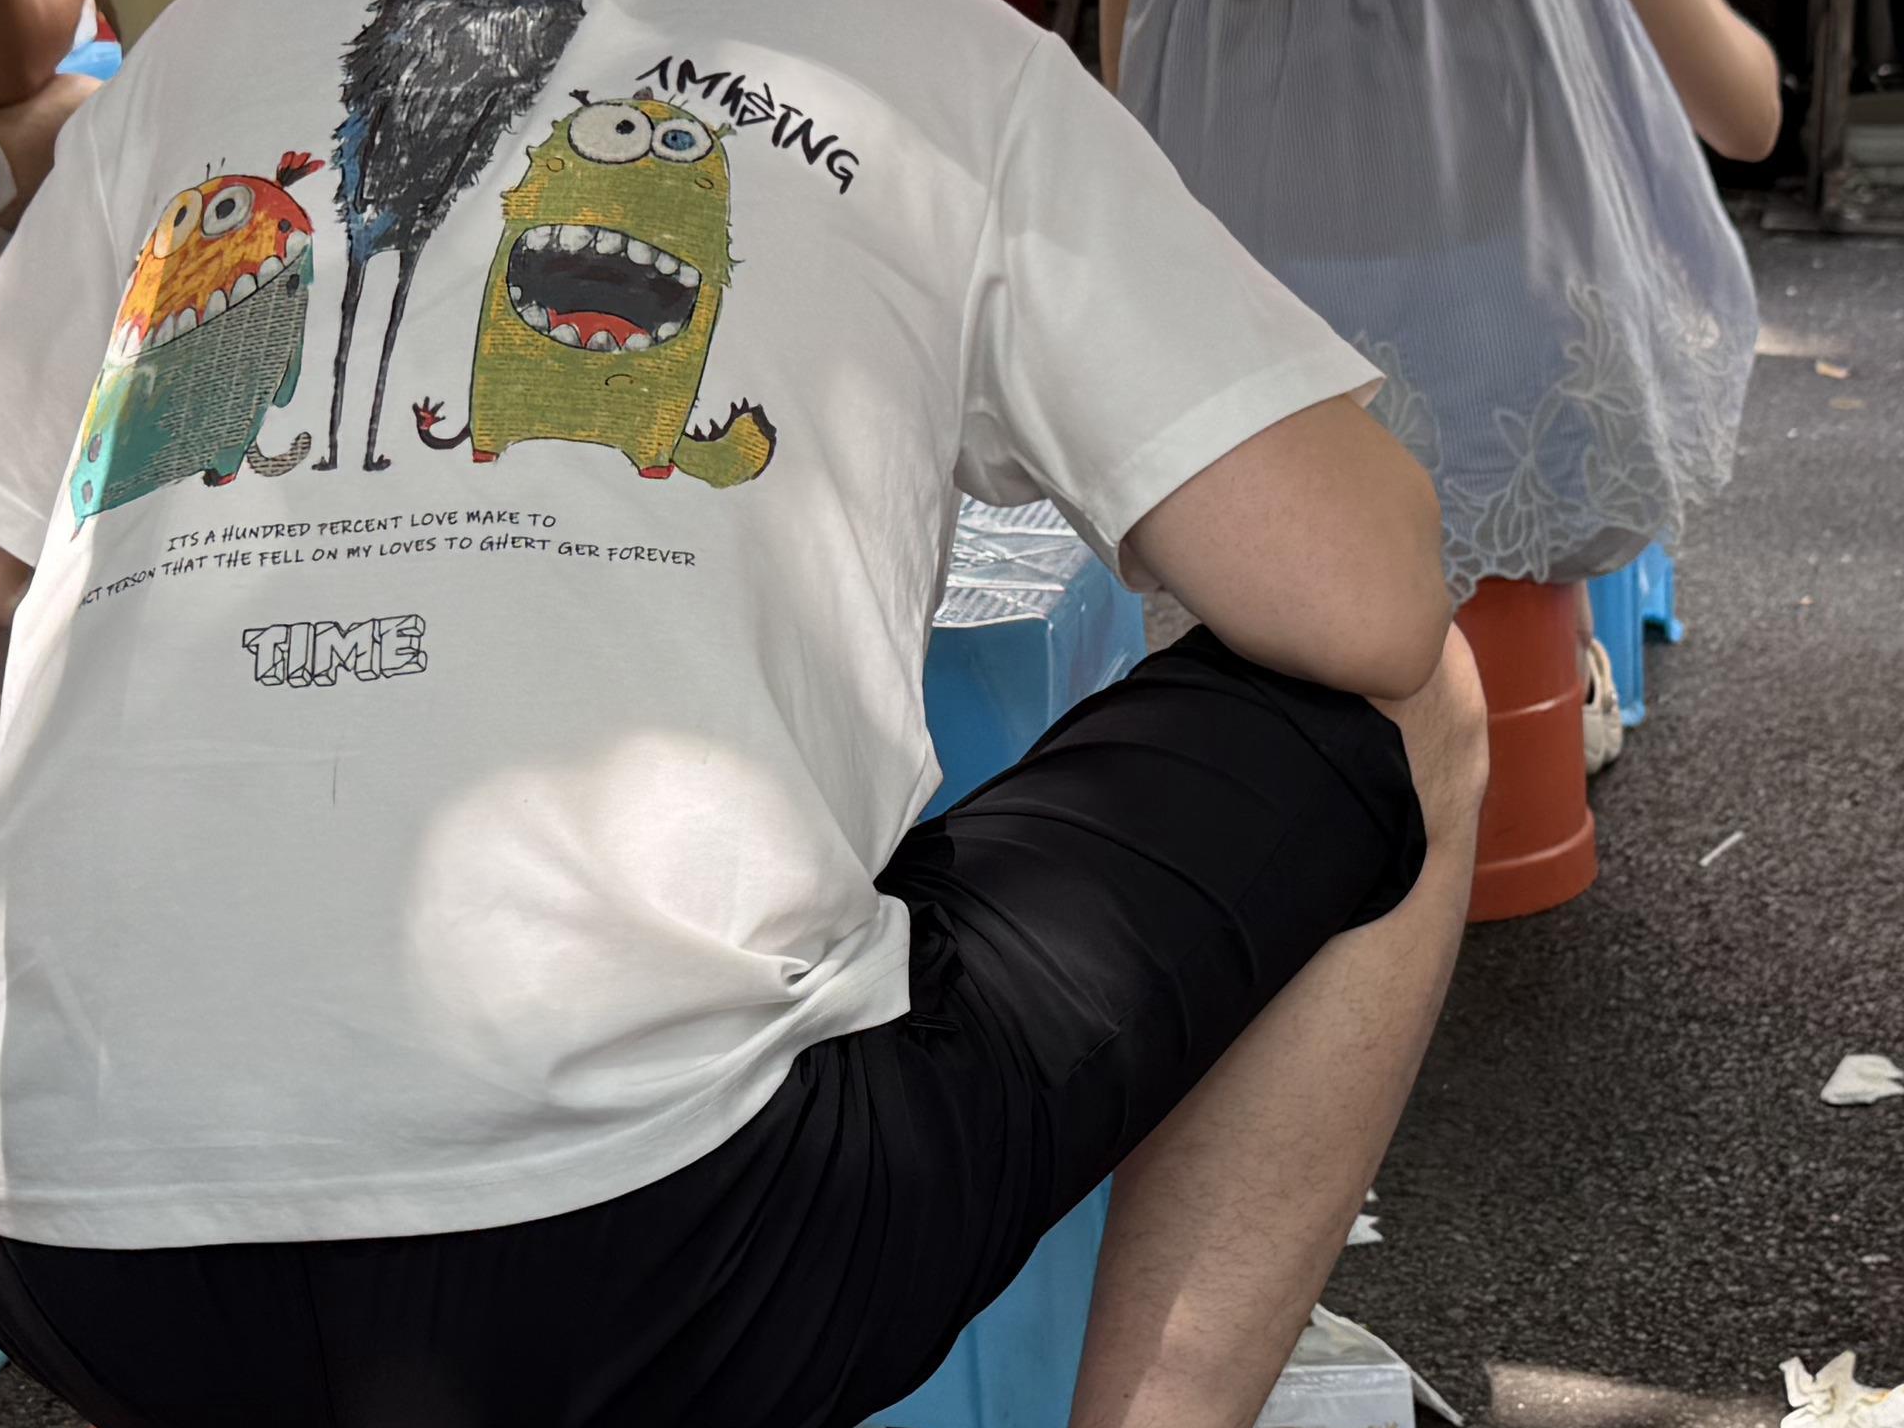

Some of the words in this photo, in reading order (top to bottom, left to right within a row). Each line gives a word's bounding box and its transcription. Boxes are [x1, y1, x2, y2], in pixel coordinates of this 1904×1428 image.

[167, 531, 200, 552] ITS
[204, 529, 216, 544] A
[222, 523, 311, 542] HUNDRED
[318, 515, 402, 535] PERCENT
[410, 511, 458, 528] LOVE
[466, 510, 521, 525] MAKE
[528, 513, 557, 528] TO
[162, 553, 209, 576] THAT
[214, 548, 252, 568] THE
[259, 549, 305, 567] FELL
[311, 547, 338, 561] ON
[346, 543, 373, 559] MY
[379, 536, 437, 557] LOVES
[444, 536, 473, 551] TO
[479, 532, 551, 552] GHERT
[558, 541, 600, 558] GER
[607, 546, 697, 567] FOREVER
[242, 614, 428, 688] TIME
